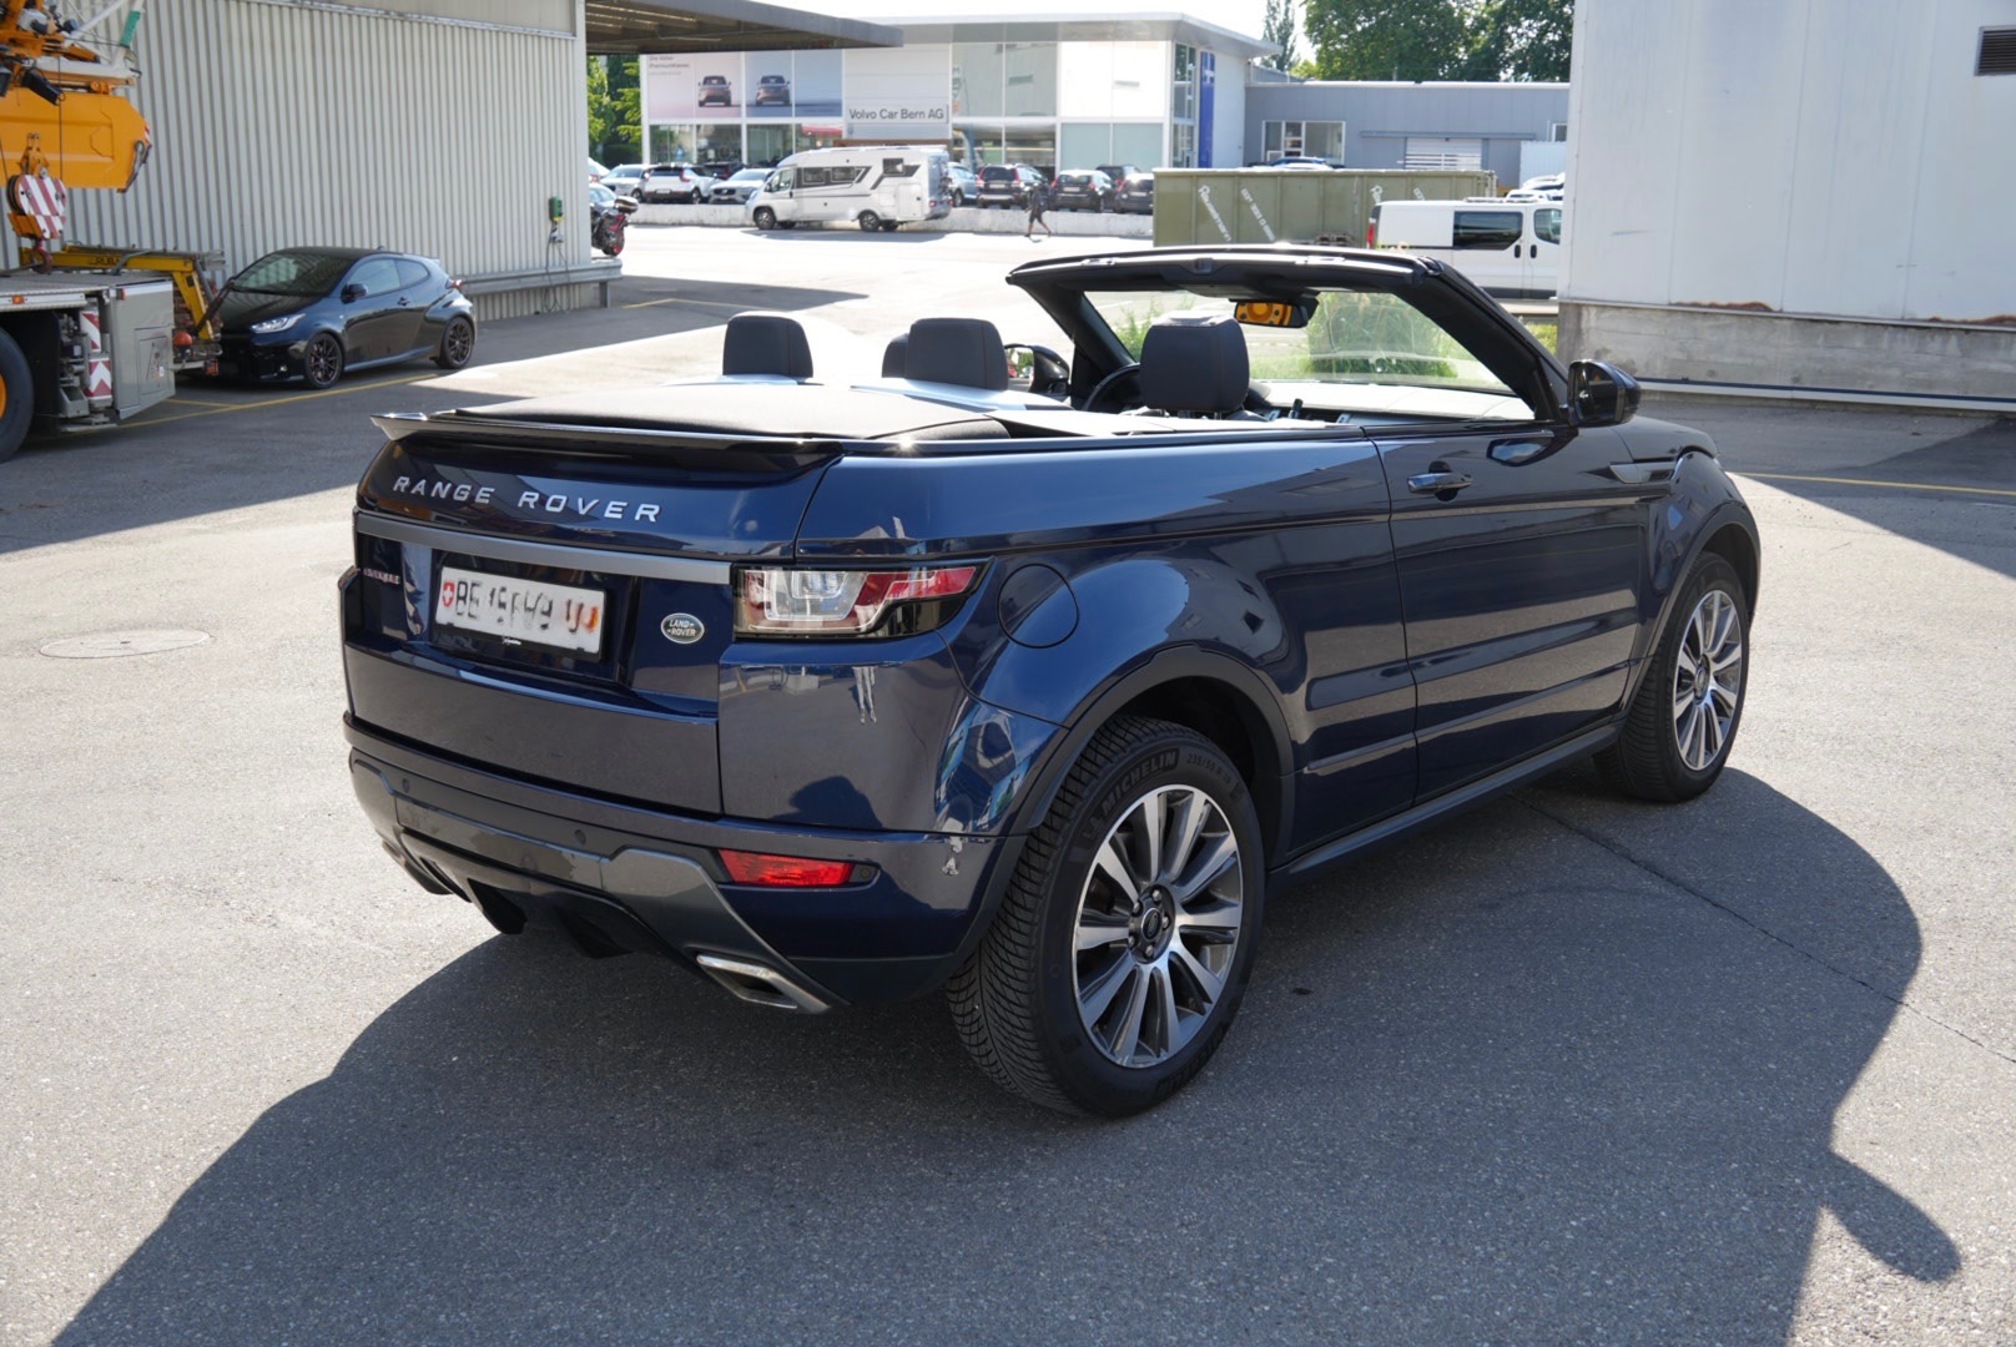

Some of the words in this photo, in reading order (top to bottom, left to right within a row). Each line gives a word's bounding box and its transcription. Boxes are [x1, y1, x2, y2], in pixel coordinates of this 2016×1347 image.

[849, 108, 877, 119] Volvo
[880, 108, 898, 119] Car
[901, 108, 925, 119] Bern
[928, 108, 944, 119] AG
[393, 476, 495, 504] RANGE
[518, 491, 661, 522] ROVER
[671, 628, 696, 637] ROVER
[1102, 750, 1176, 815] MICHELIN
